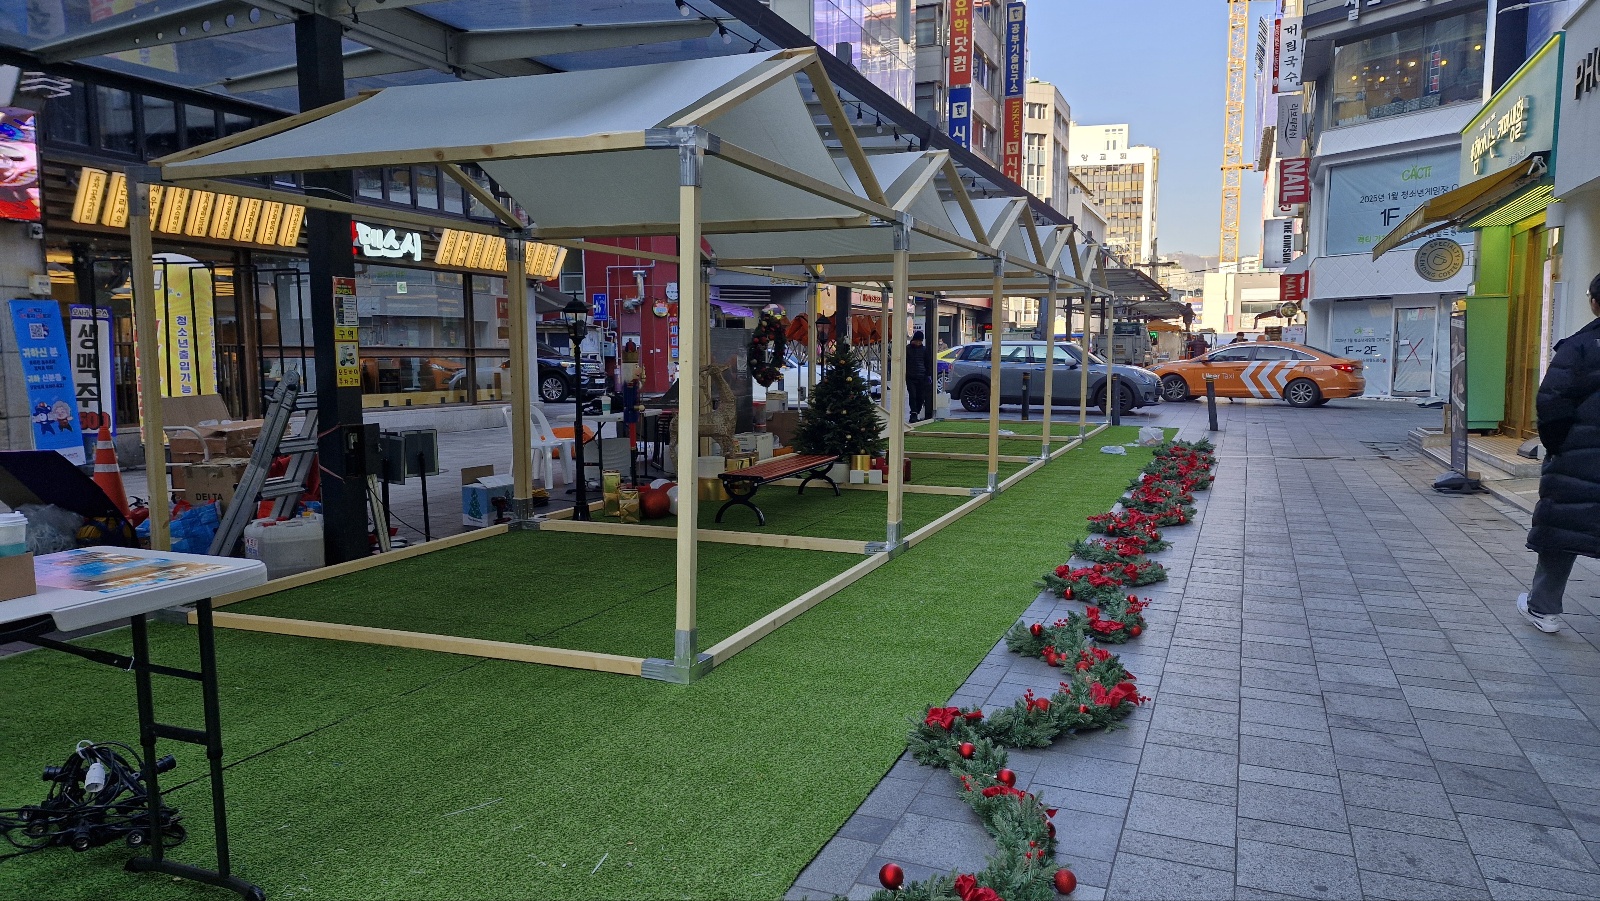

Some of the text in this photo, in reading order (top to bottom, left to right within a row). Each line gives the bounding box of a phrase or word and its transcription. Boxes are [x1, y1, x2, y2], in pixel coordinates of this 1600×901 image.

[1009, 24, 1021, 93] 공부기술연구소
[953, 126, 967, 149] 시
[1283, 160, 1305, 202] NAIL
[1359, 193, 1385, 203] 2025년
[1387, 191, 1399, 201] 1월
[1400, 185, 1449, 199] 청소년게임장
[1283, 221, 1292, 233] THE
[1380, 206, 1400, 227] 1F
[1282, 236, 1292, 264] DIMSUM
[1430, 241, 1461, 259] SPECIALTY
[1419, 252, 1460, 278] BLENDING COFFEE
[1285, 276, 1296, 300] NAIL
[176, 315, 192, 394] 청소년출입가능
[1344, 345, 1354, 355] 1F
[1364, 345, 1377, 355] 2F
[77, 324, 99, 408] 생맥주
[195, 493, 224, 501] DELTA
